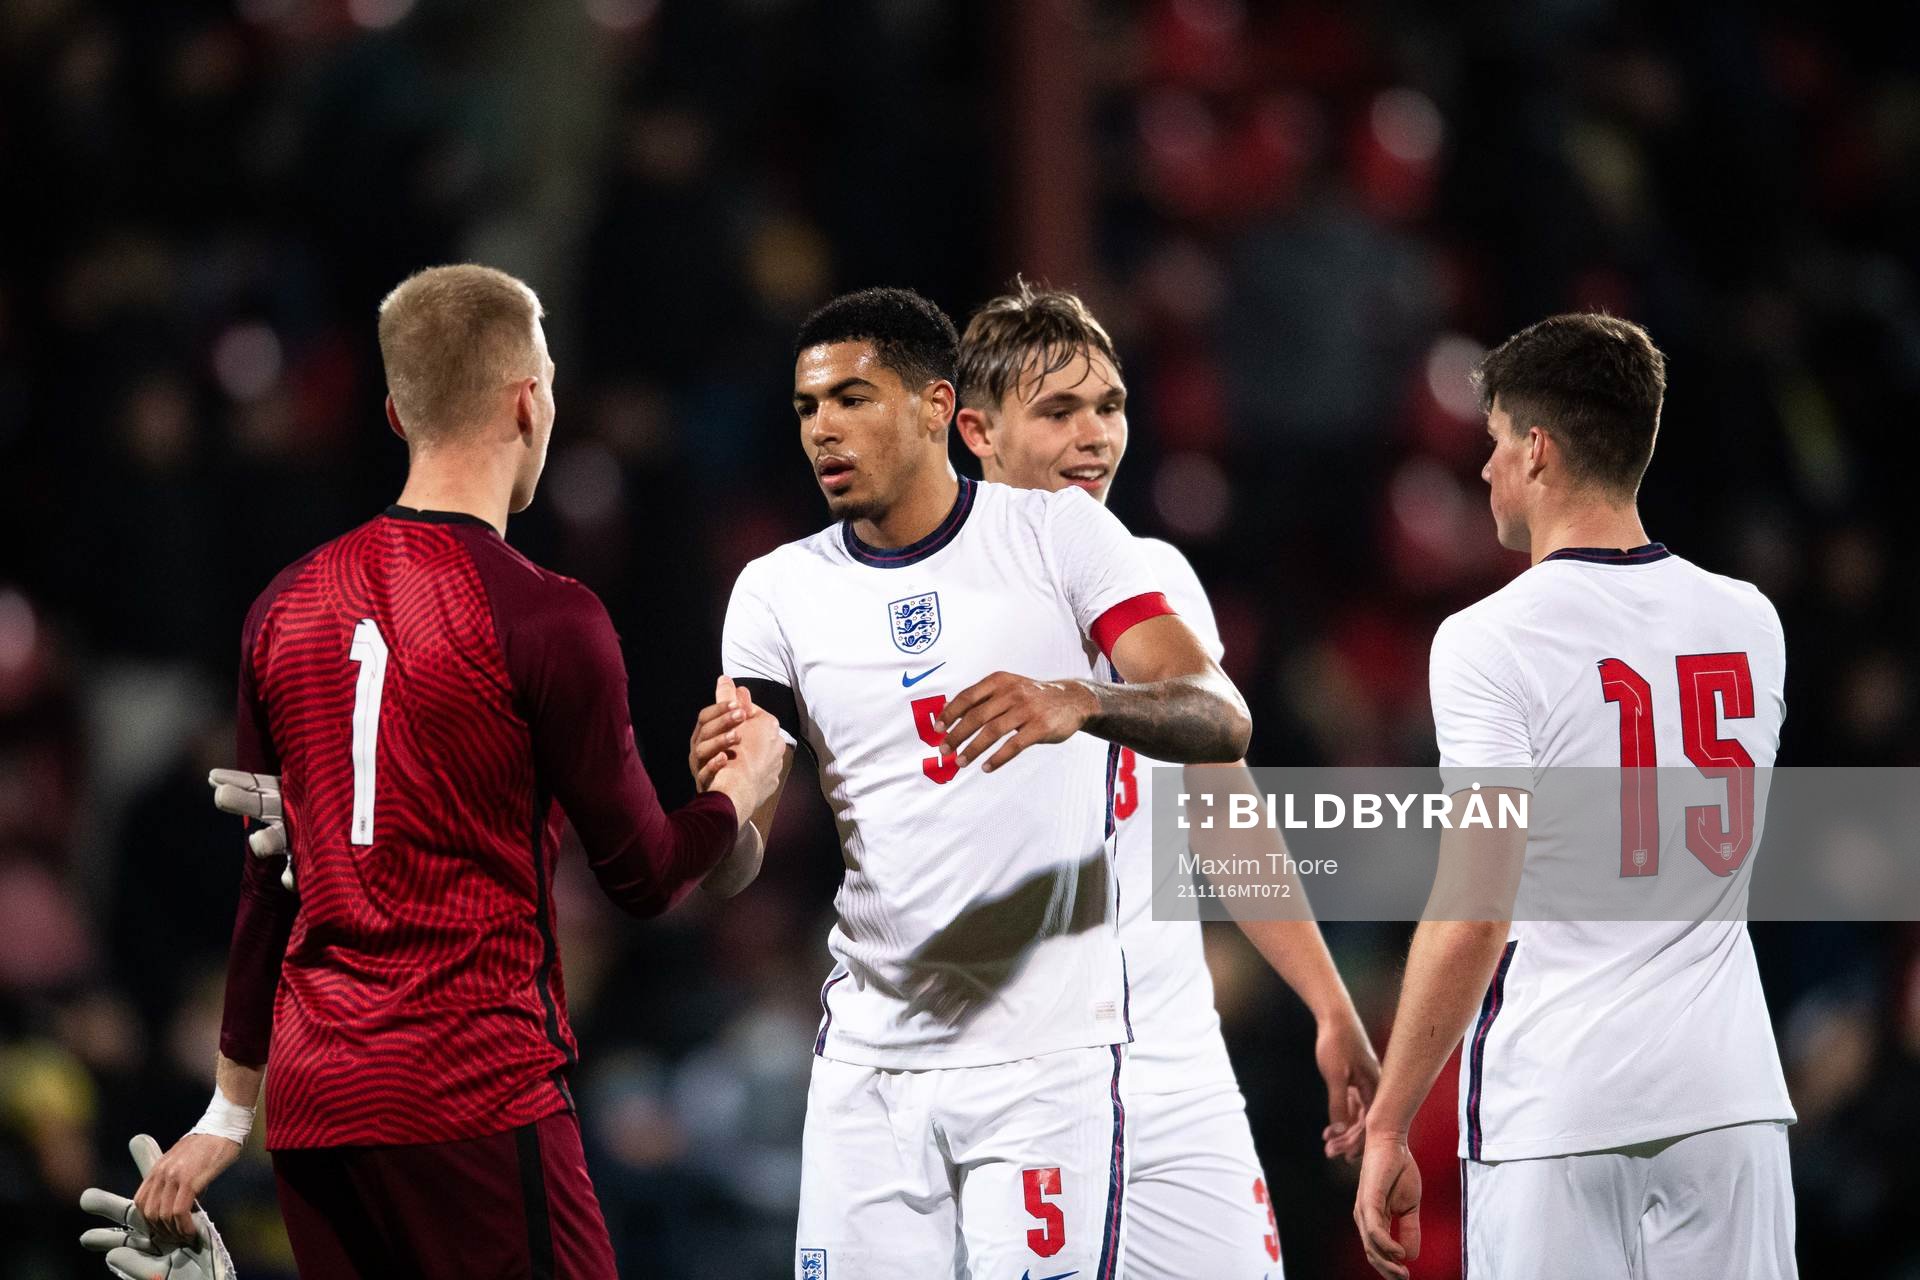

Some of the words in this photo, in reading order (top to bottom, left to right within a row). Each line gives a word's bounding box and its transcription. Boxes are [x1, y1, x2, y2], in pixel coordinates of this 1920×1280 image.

[349, 618, 389, 846] 1
[911, 694, 962, 785] 5
[1597, 652, 1755, 878] 15
[1022, 1167, 1066, 1258] 5
